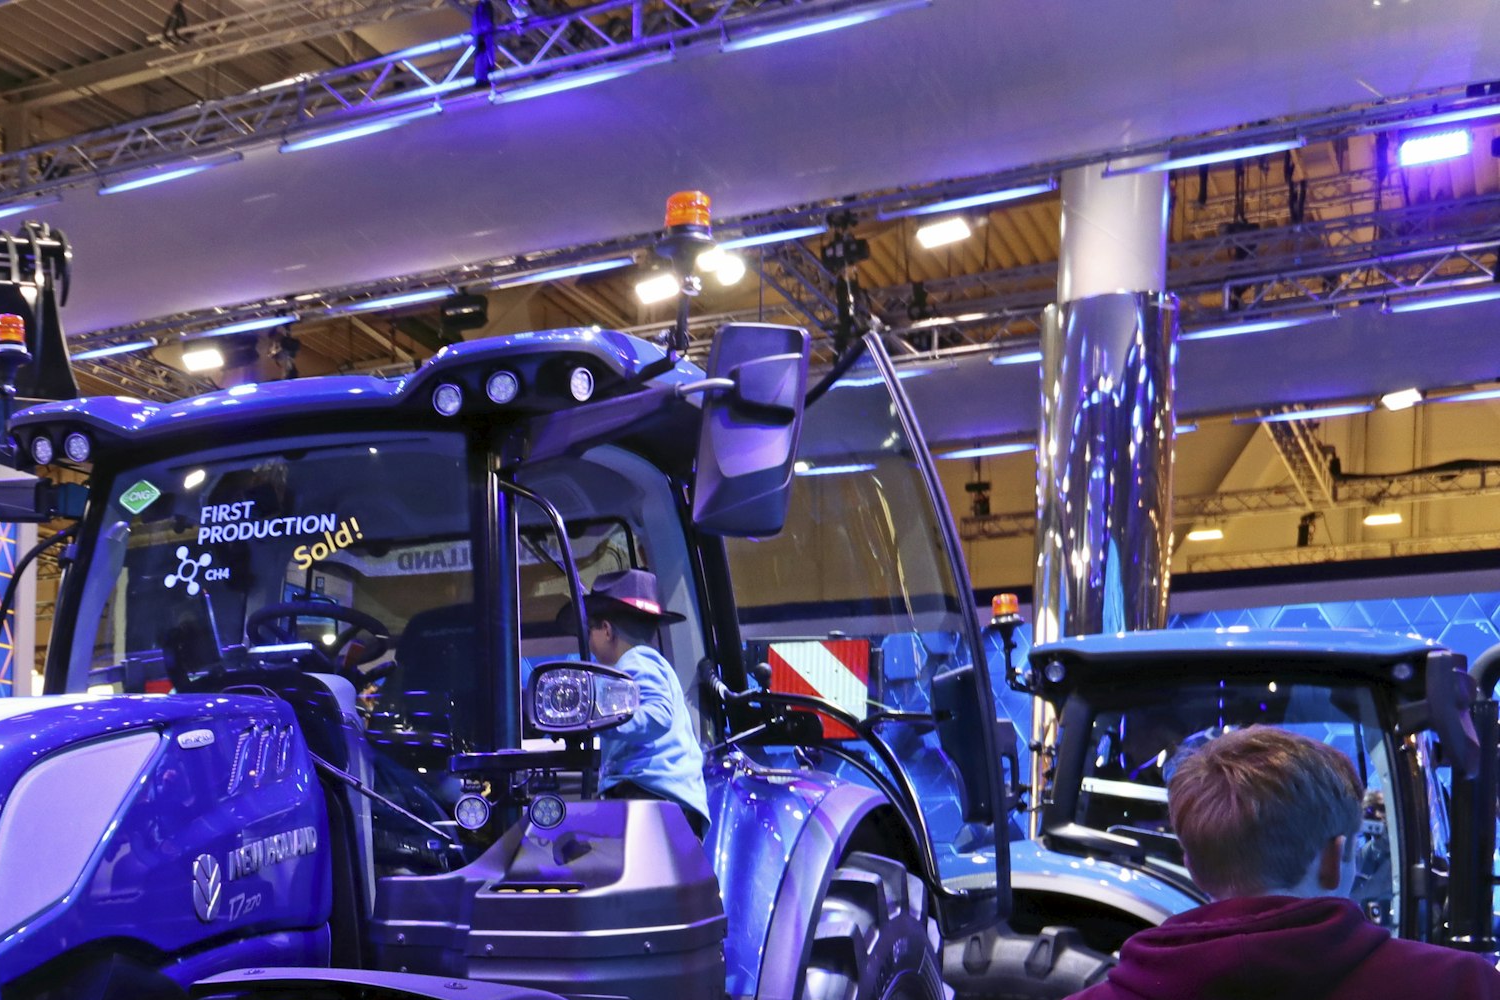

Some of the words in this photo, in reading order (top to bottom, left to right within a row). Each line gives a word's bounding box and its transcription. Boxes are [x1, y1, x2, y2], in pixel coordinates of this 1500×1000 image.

[197, 513, 337, 545] PRODUCTION
[200, 501, 255, 525] FIRST
[293, 516, 364, 571] Sold!
[204, 567, 230, 581] CH4
[228, 839, 264, 881] NEW
